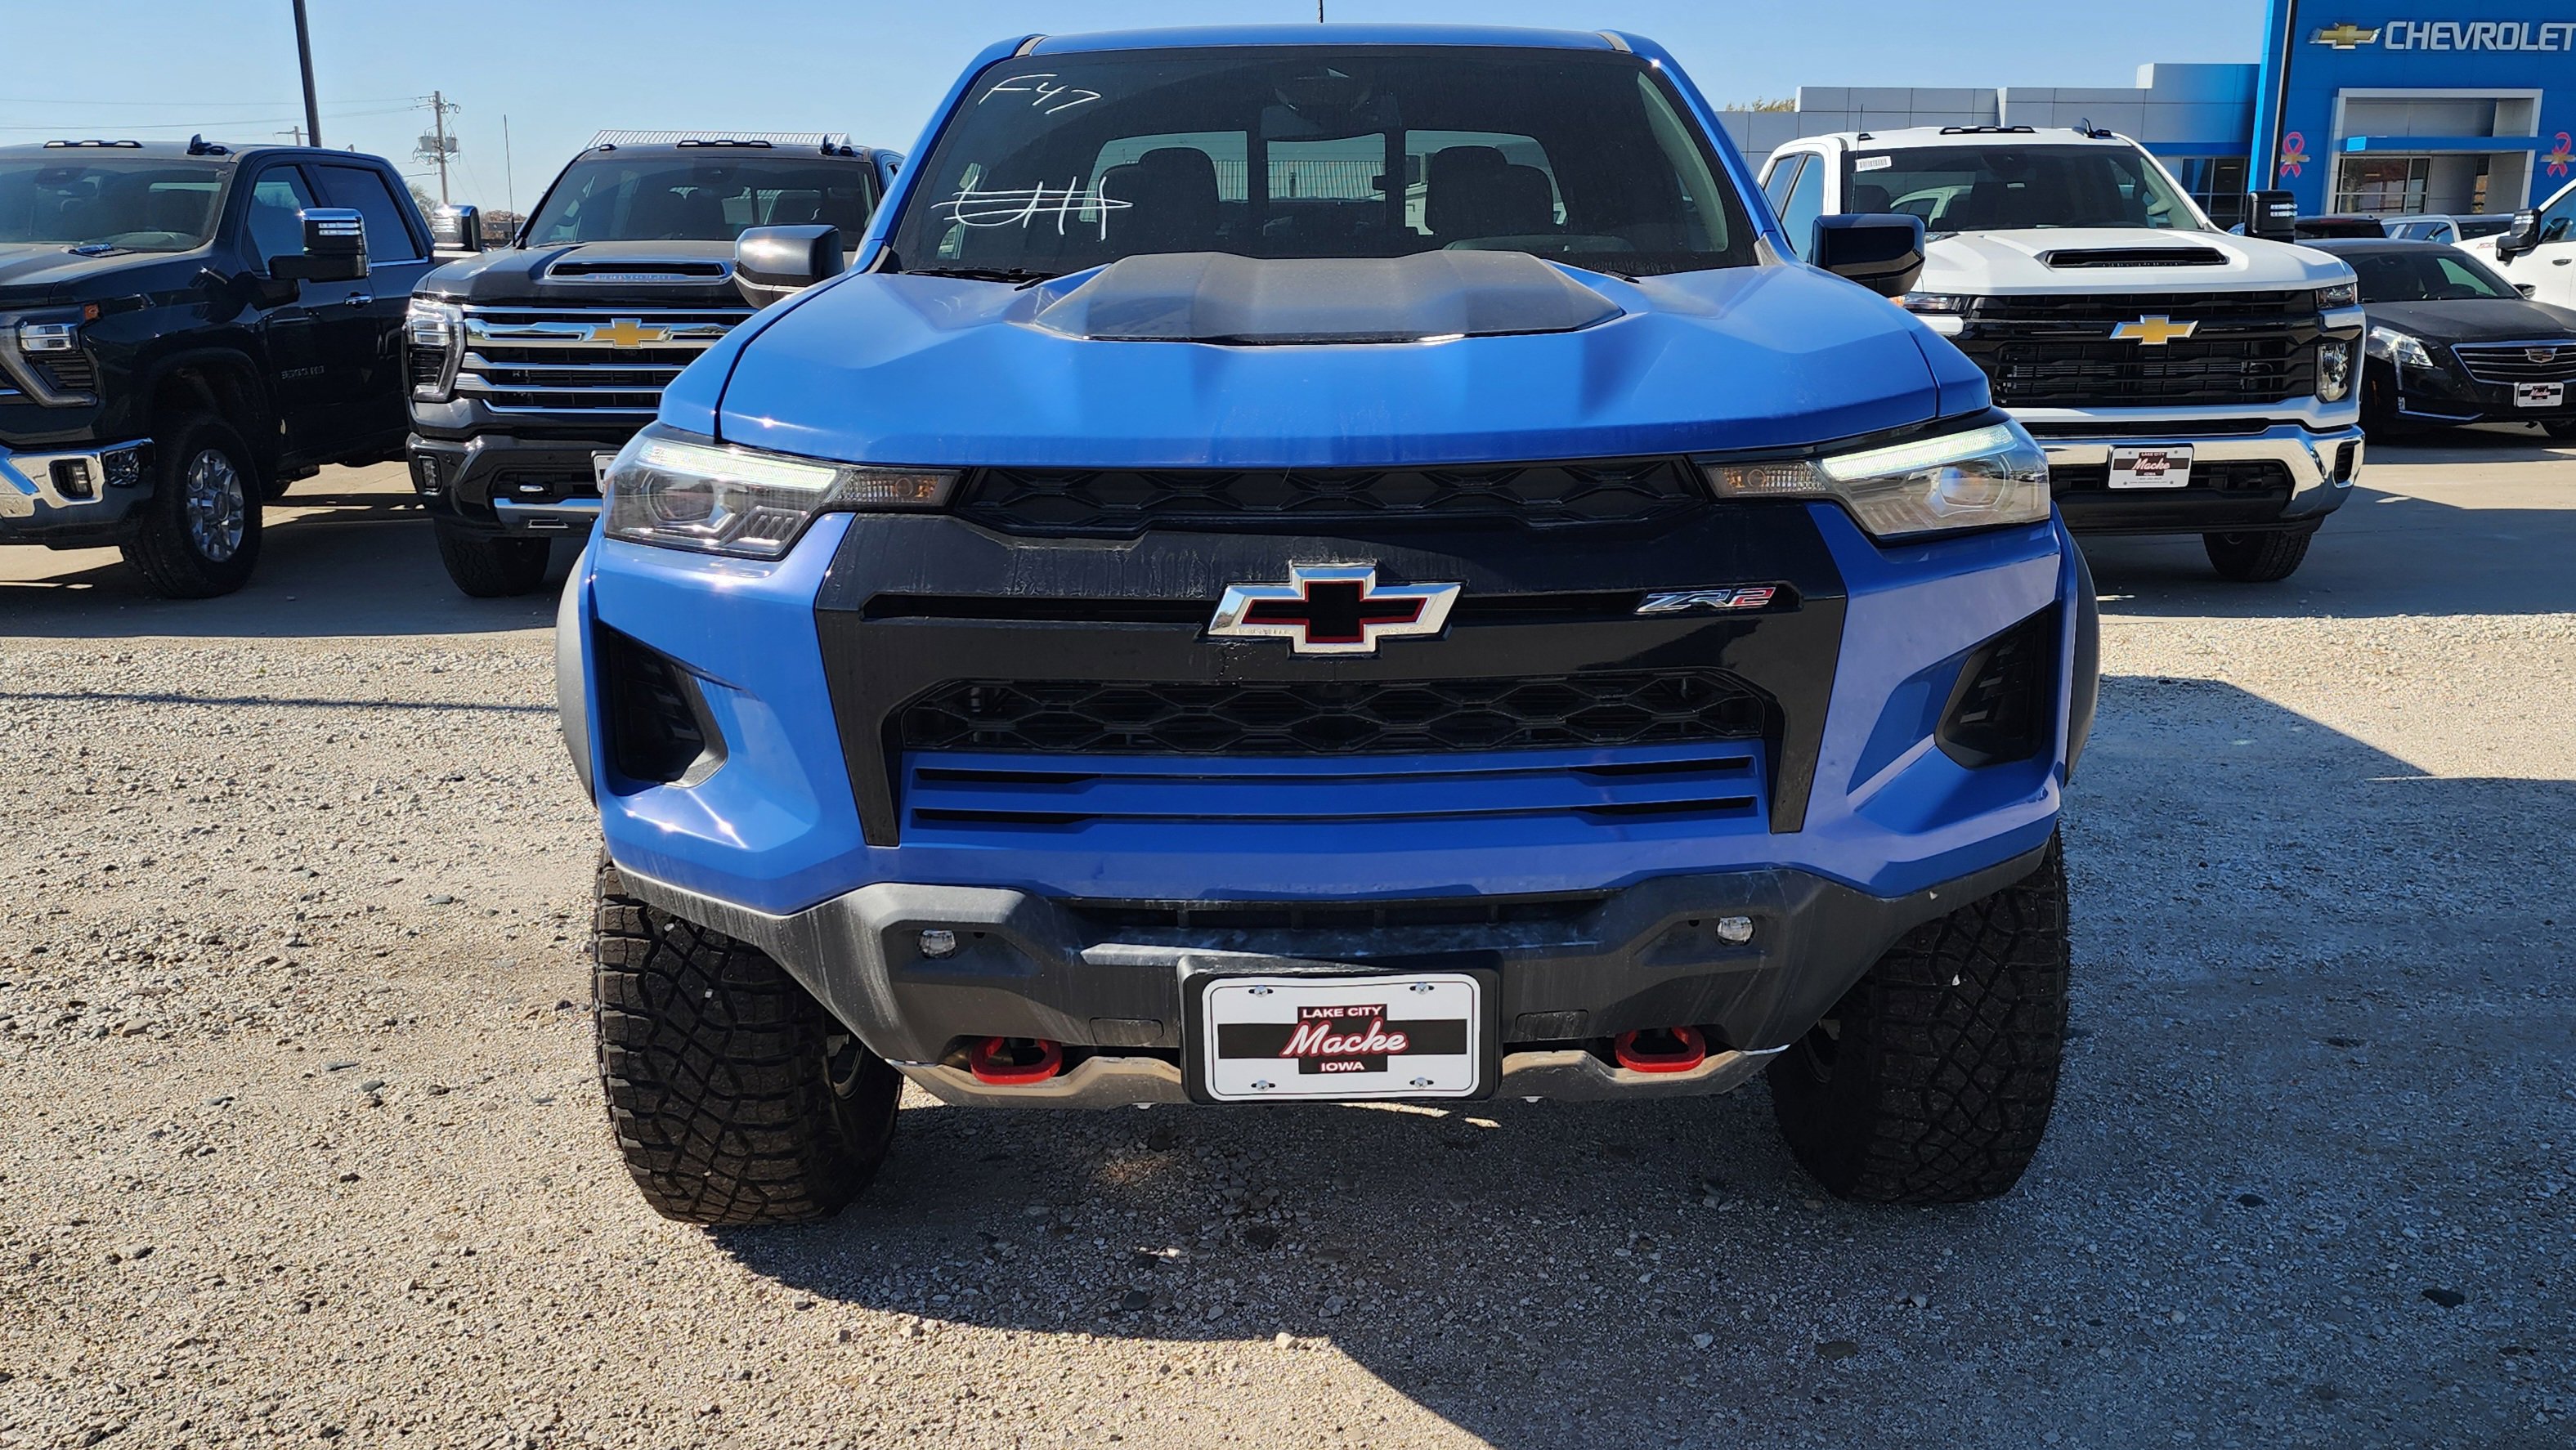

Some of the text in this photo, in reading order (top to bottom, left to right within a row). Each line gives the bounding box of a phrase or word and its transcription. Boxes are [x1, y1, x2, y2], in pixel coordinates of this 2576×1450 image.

[2385, 21, 2576, 51] CHEVROLET
[2131, 458, 2171, 470] Macke
[1635, 587, 1776, 613] ZR2
[1302, 1005, 1382, 1018] LAKE CITY
[1280, 1018, 1409, 1057] Macke
[1320, 1061, 1365, 1072] IOWA
